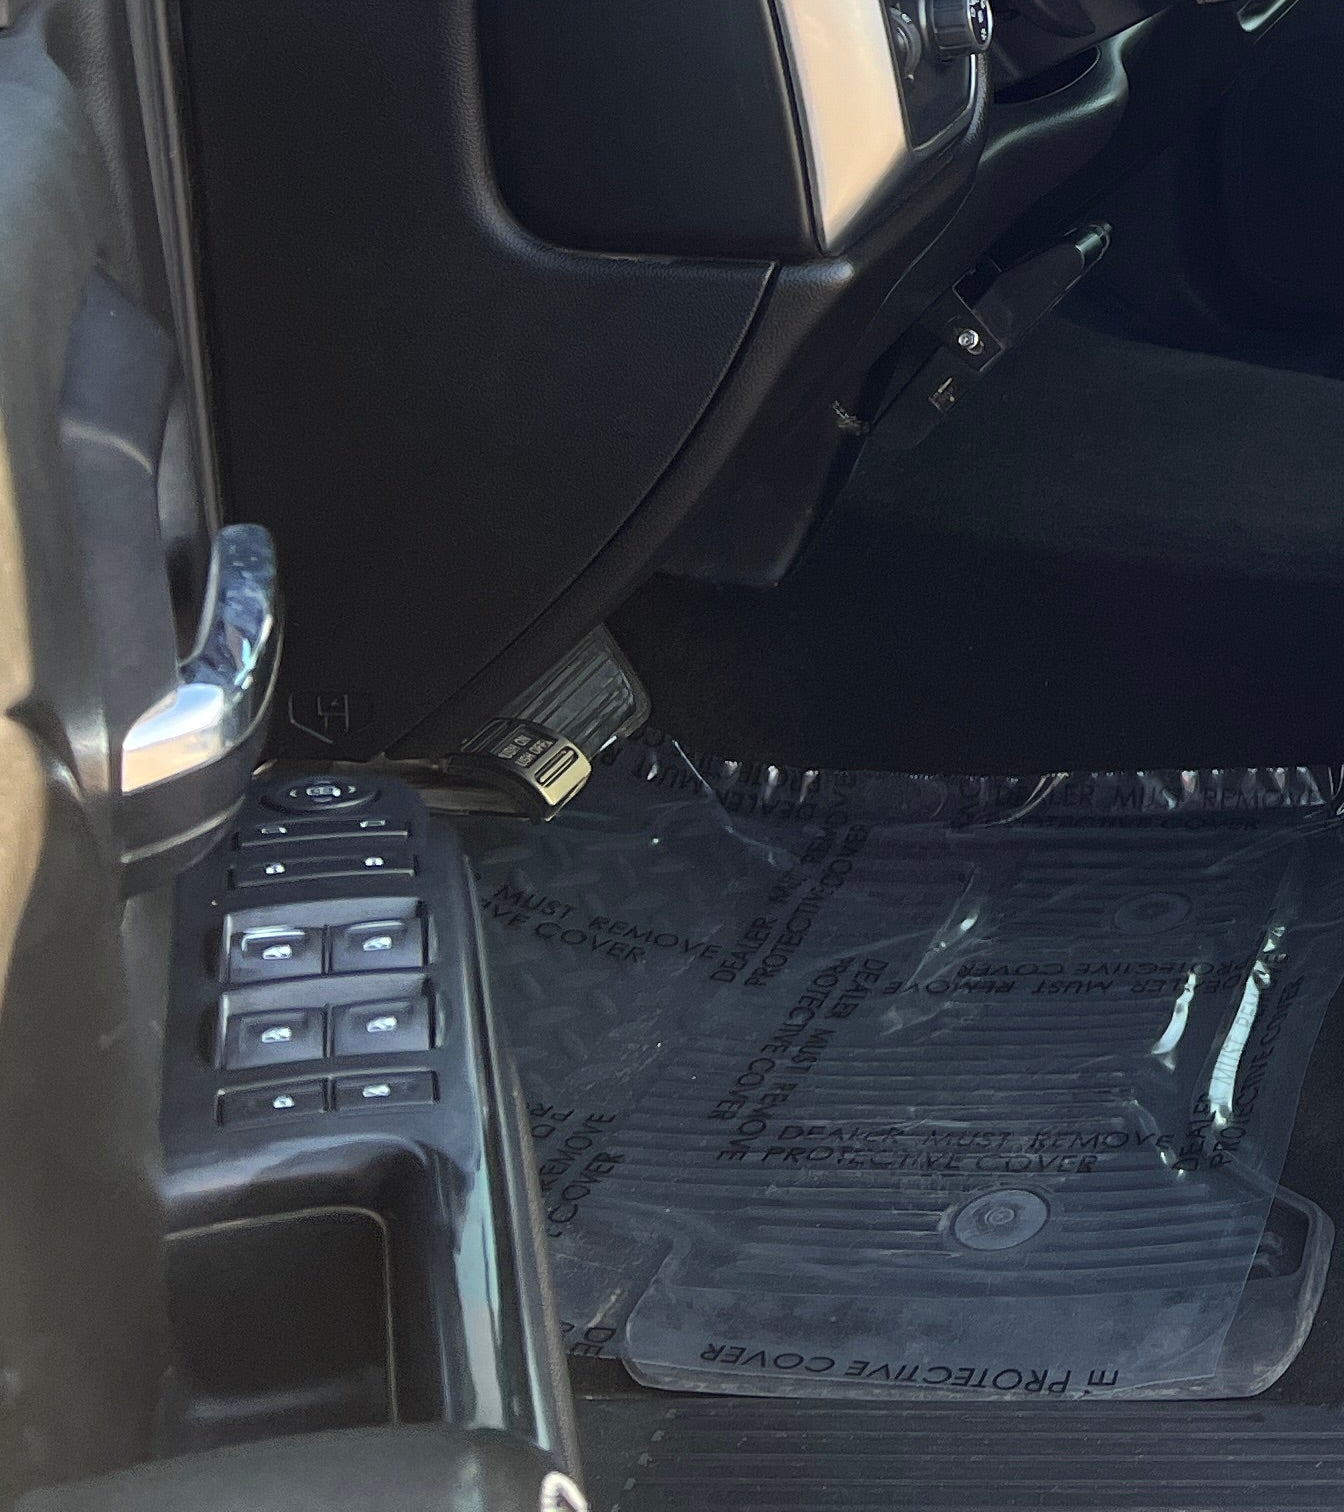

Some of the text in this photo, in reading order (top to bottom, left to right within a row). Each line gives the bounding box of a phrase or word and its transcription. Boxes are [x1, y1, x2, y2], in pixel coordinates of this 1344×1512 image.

[493, 884, 577, 920] MUST
[588, 915, 723, 959] REMOVE
[534, 921, 646, 964] COVER
[957, 959, 1065, 978] COVER
[1033, 979, 1110, 995] MUST
[707, 1057, 776, 1121] COVER
[1028, 1129, 1176, 1151] REMOVE
[975, 1152, 1101, 1174] COVER
[548, 1151, 625, 1225] COVER
[699, 1341, 836, 1374] COVER
[844, 1359, 1073, 1396] PROTECTIVE
